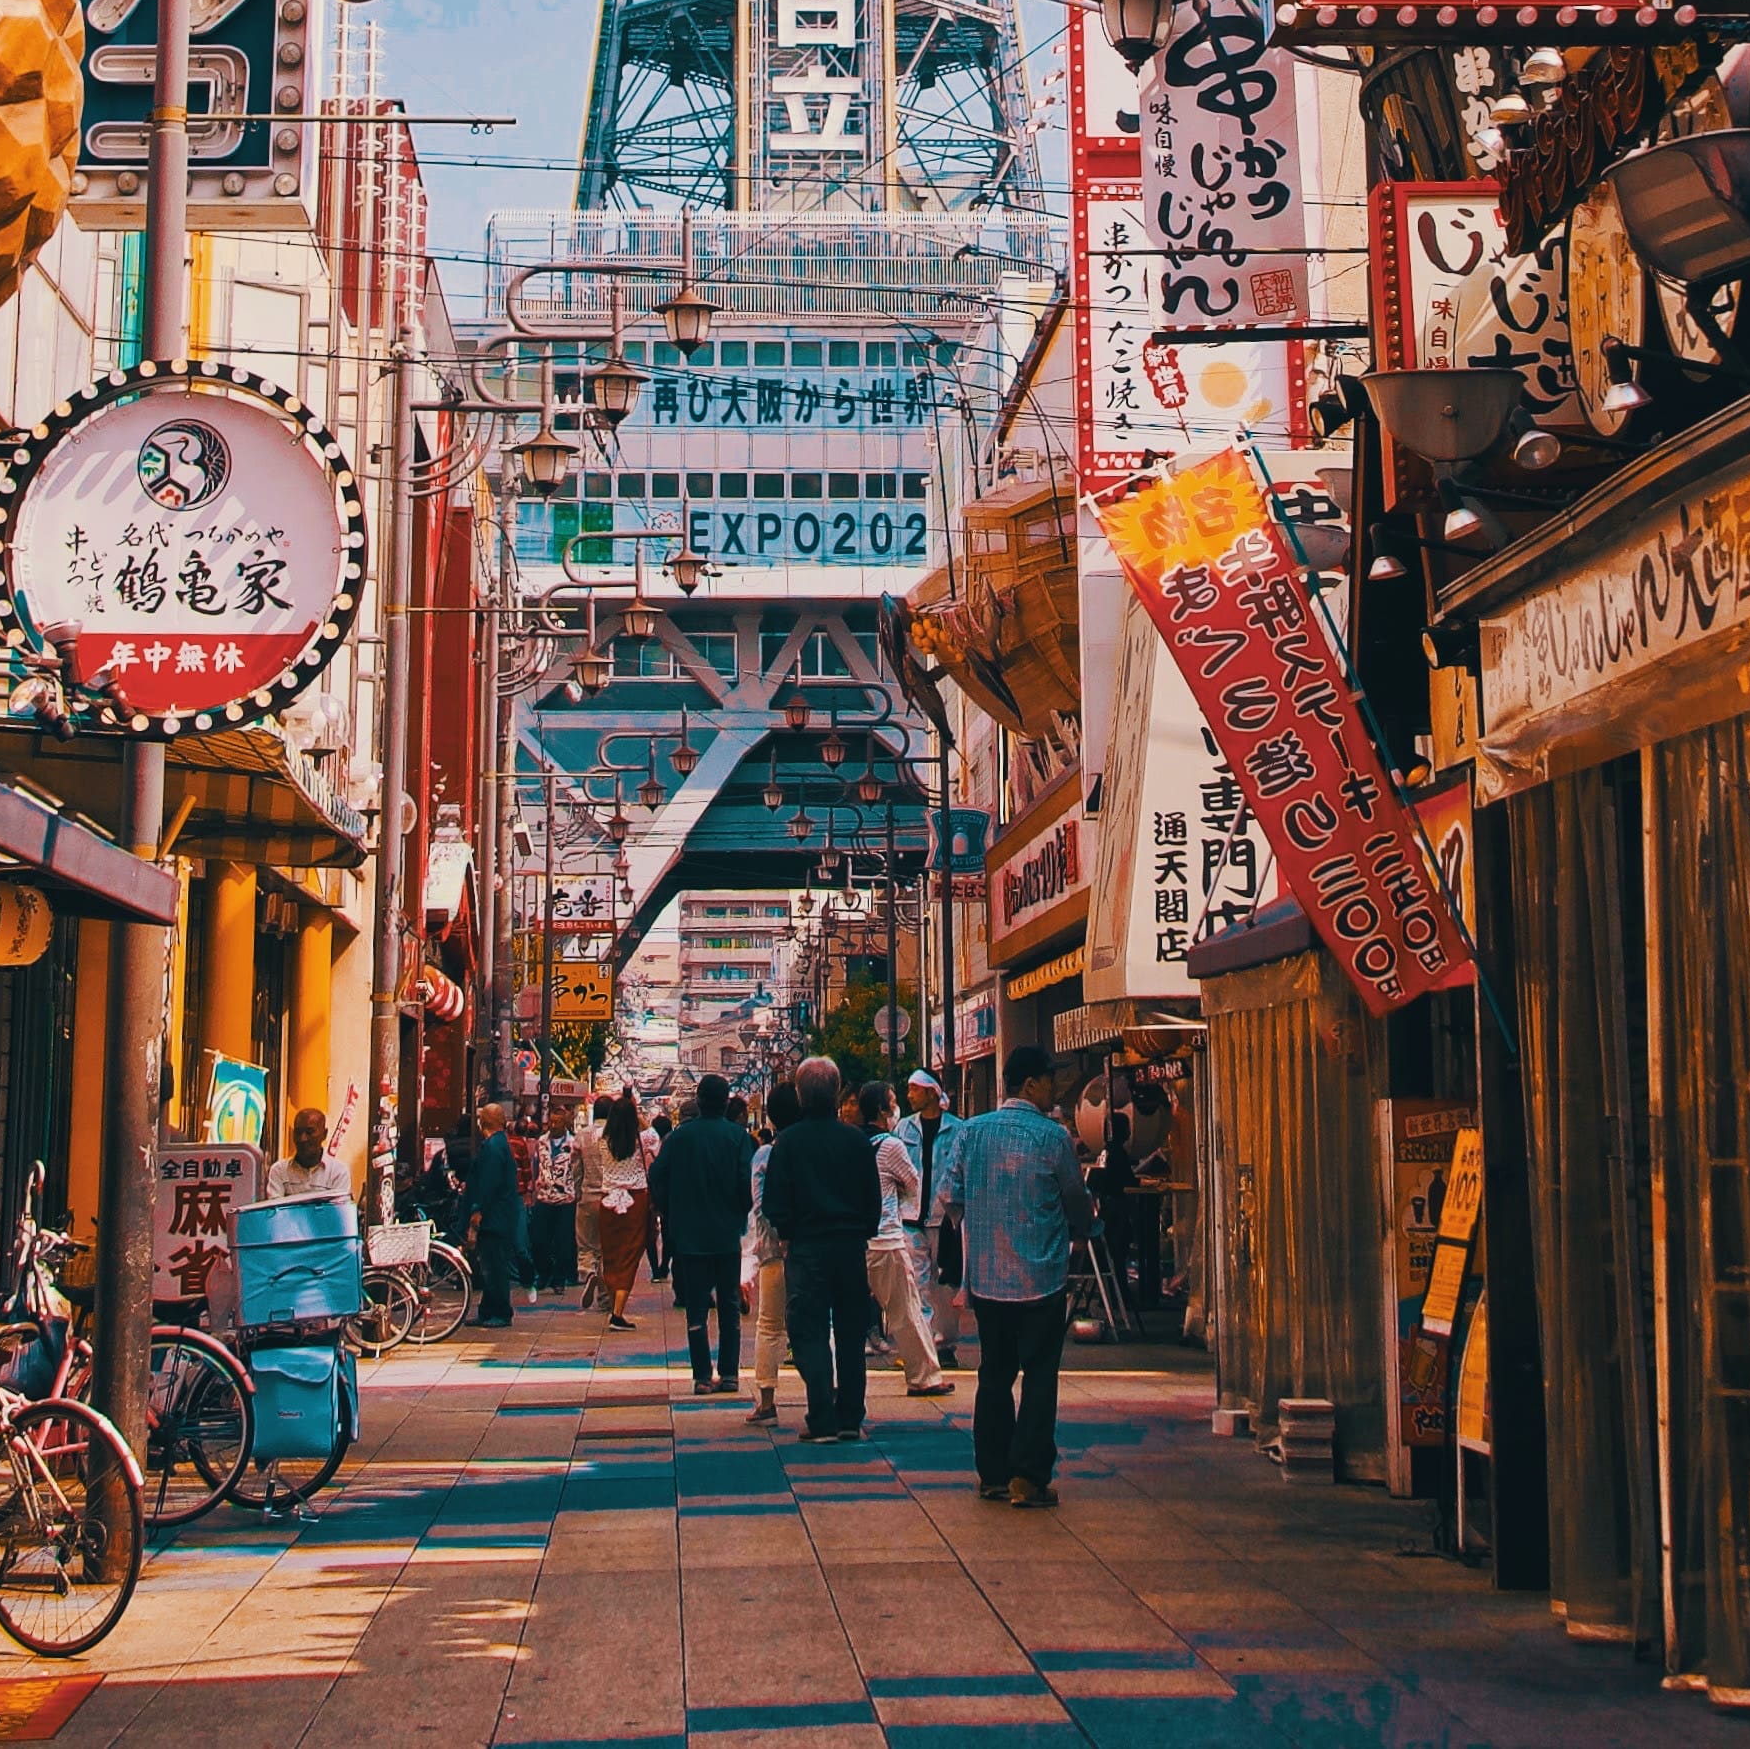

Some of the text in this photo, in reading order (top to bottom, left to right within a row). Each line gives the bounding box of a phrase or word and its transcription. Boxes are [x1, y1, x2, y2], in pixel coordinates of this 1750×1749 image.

[1149, 93, 1179, 179] 味自慢
[1164, 15, 1290, 221] 串かつ
[1103, 220, 1140, 440] 串かつ たこ焼き
[653, 377, 930, 425] 再び大阪から世界
[64, 523, 90, 588] 串かつ
[115, 522, 174, 548] 名代
[111, 548, 294, 616] 鶴亀家
[105, 639, 246, 674] 年中無休
[1153, 811, 1190, 964] 通天閣店
[159, 1158, 245, 1181] 全自動卓
